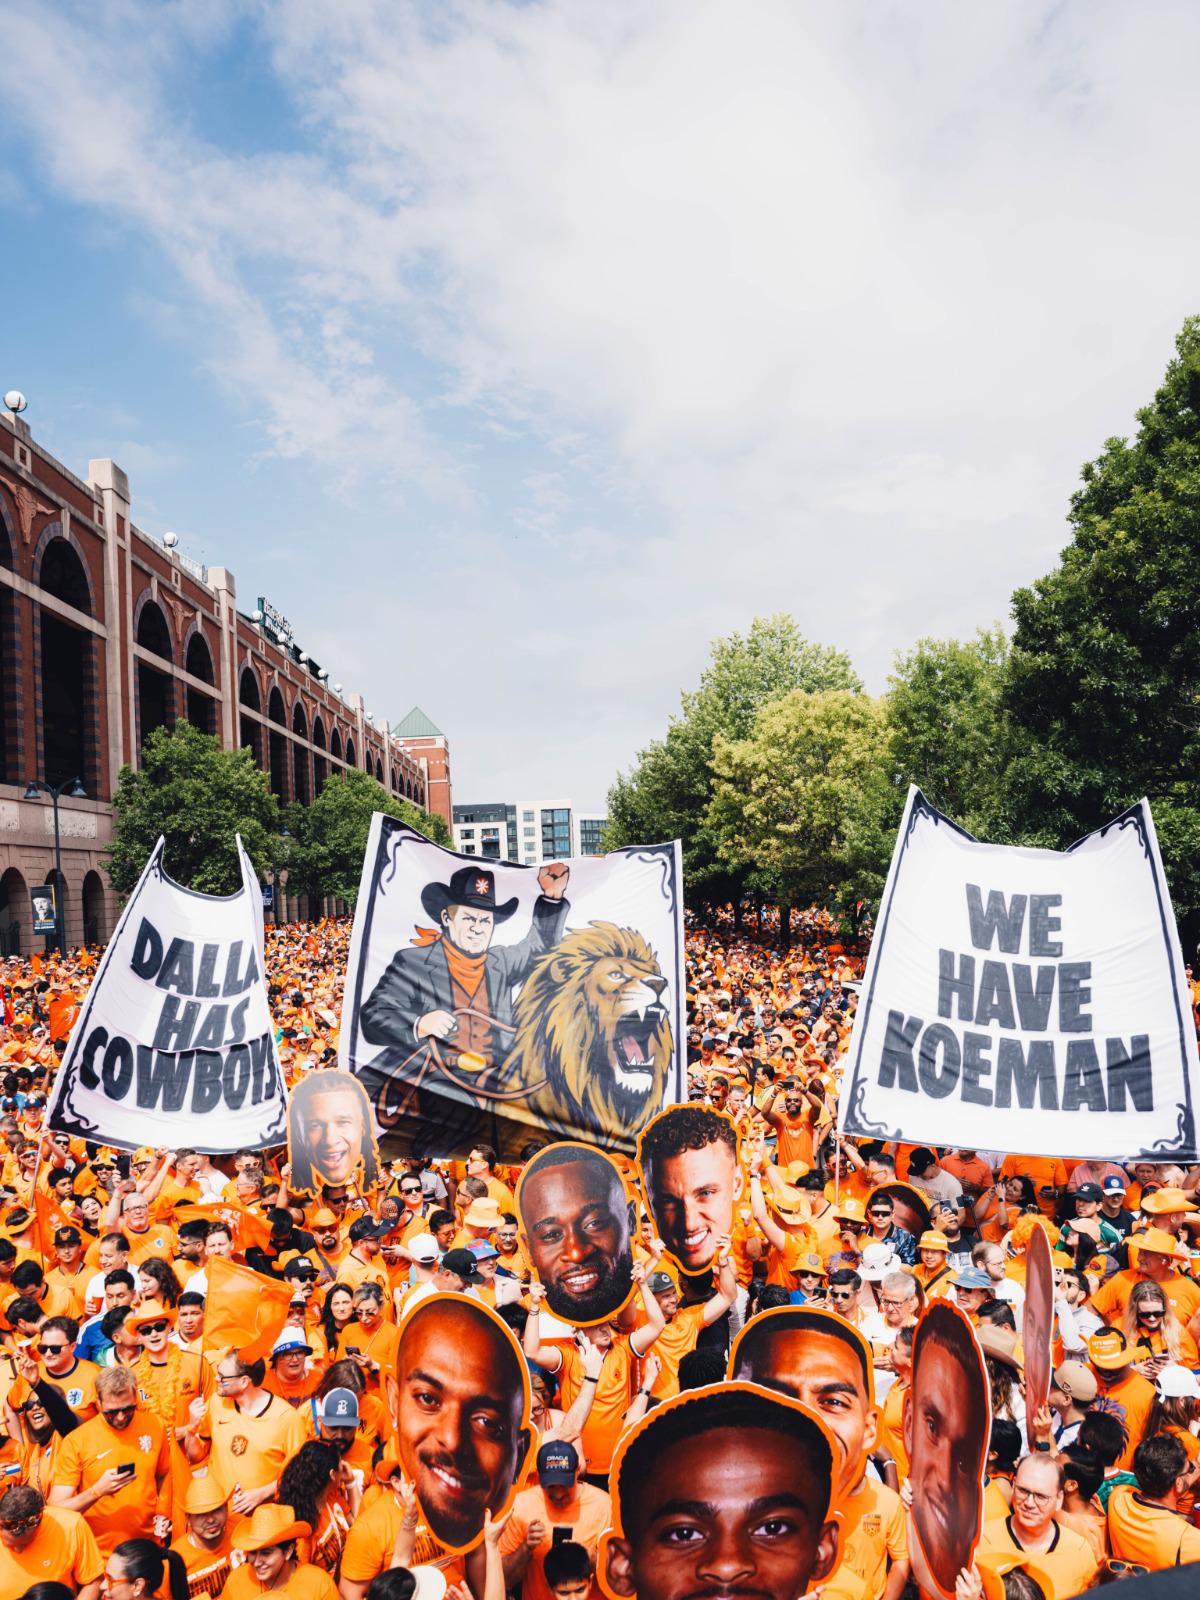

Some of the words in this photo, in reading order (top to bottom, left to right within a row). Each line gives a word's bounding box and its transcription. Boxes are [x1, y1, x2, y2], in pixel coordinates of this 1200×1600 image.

[966, 883, 1063, 957] WE
[152, 994, 250, 1050] HAS
[937, 948, 1093, 1032] HAVE
[80, 1026, 277, 1113] COWBOYS
[877, 1009, 1154, 1112] KOEMAN
